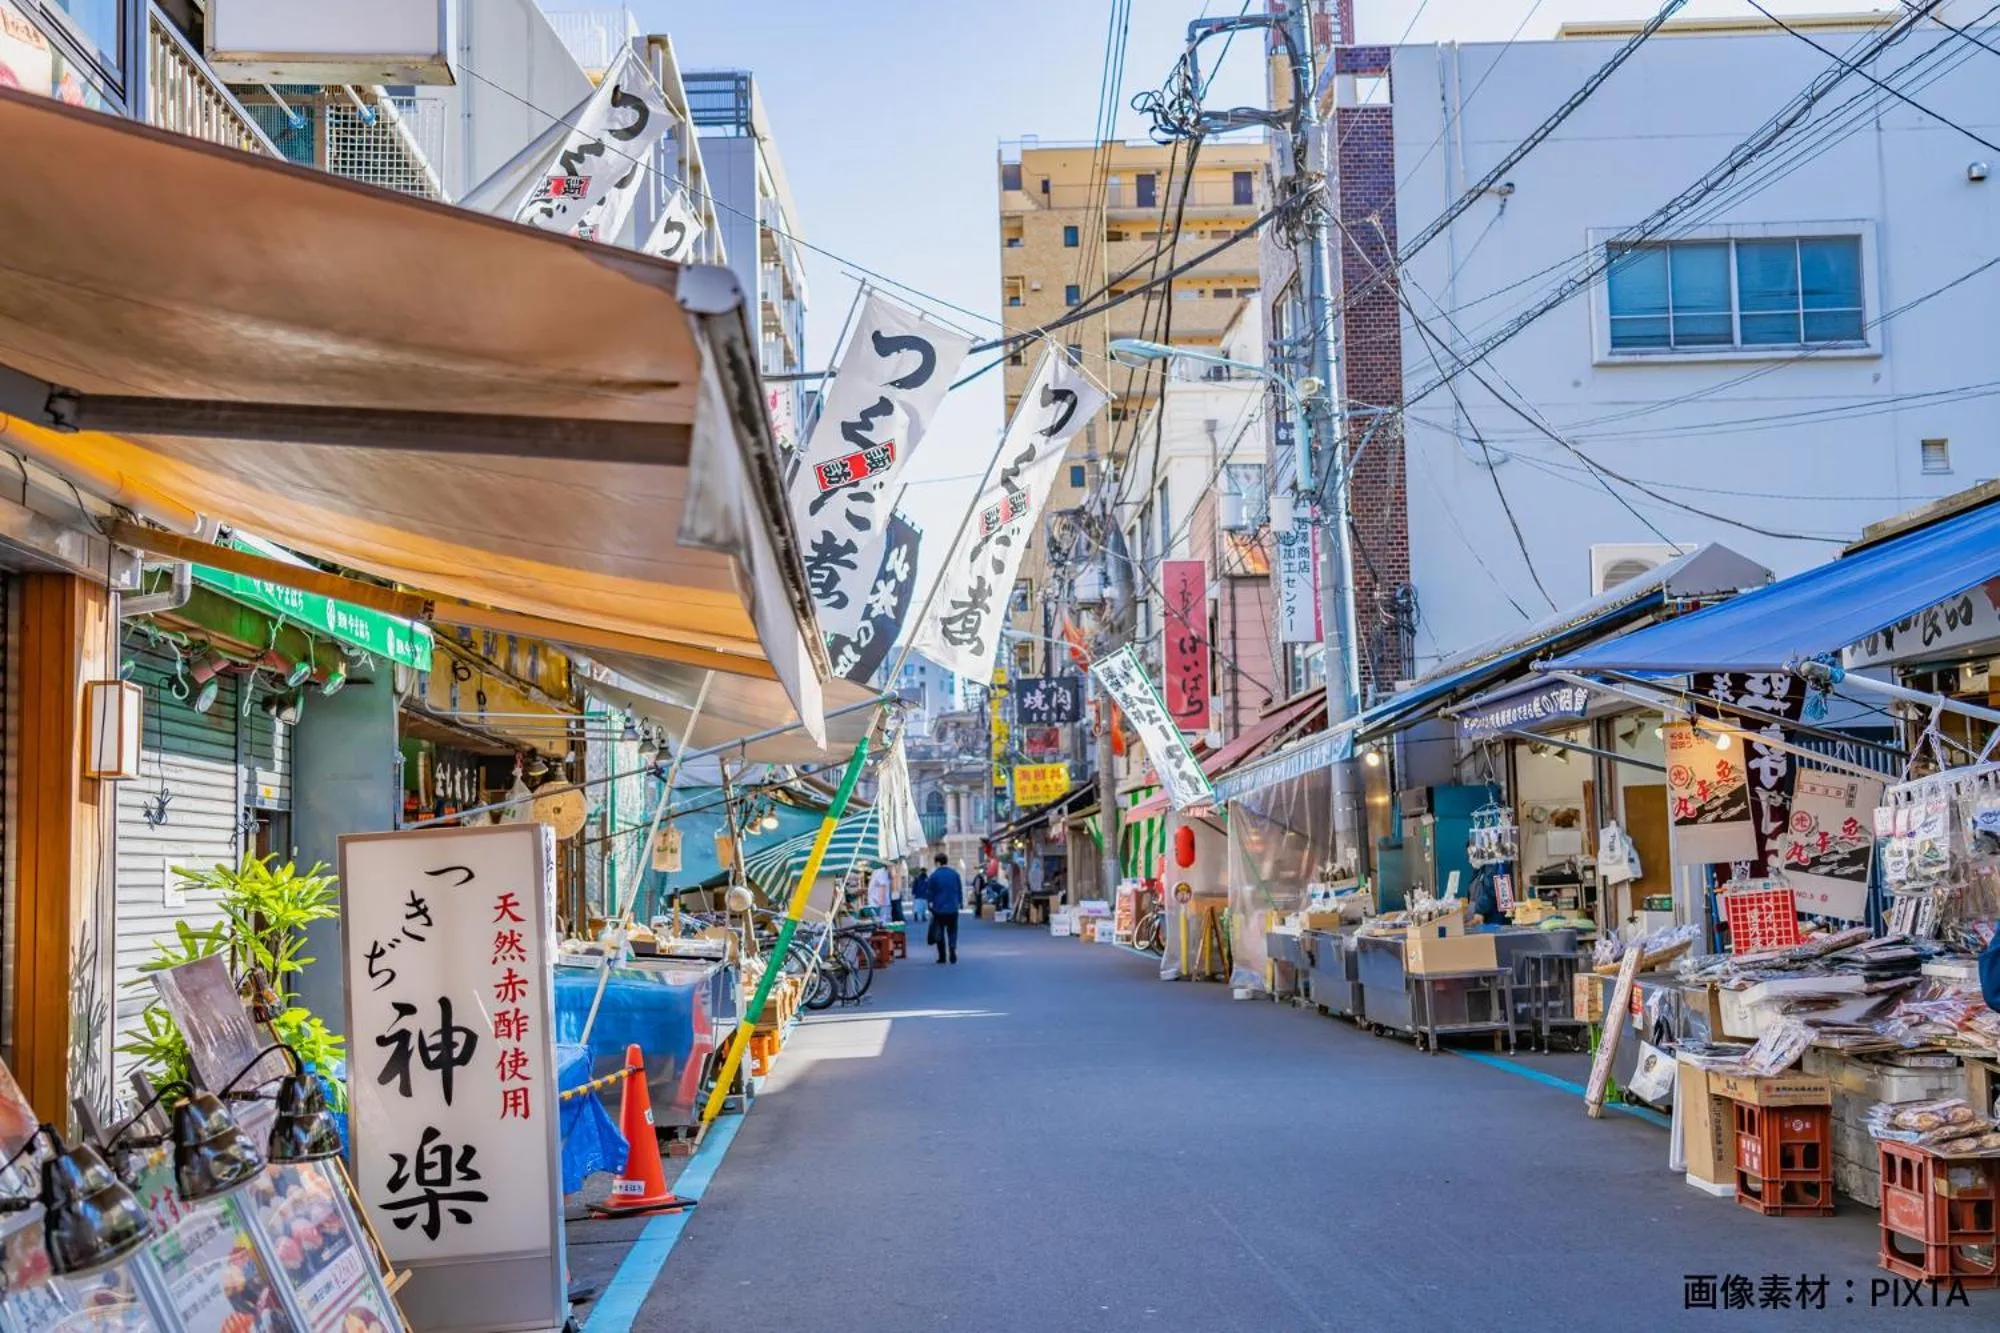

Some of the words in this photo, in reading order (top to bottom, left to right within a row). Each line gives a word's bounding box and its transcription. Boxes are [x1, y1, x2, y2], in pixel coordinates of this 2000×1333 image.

[1023, 686, 1072, 712] 焼肉
[375, 995, 489, 1242] 神楽
[491, 891, 531, 1121] 天然赤酢使用
